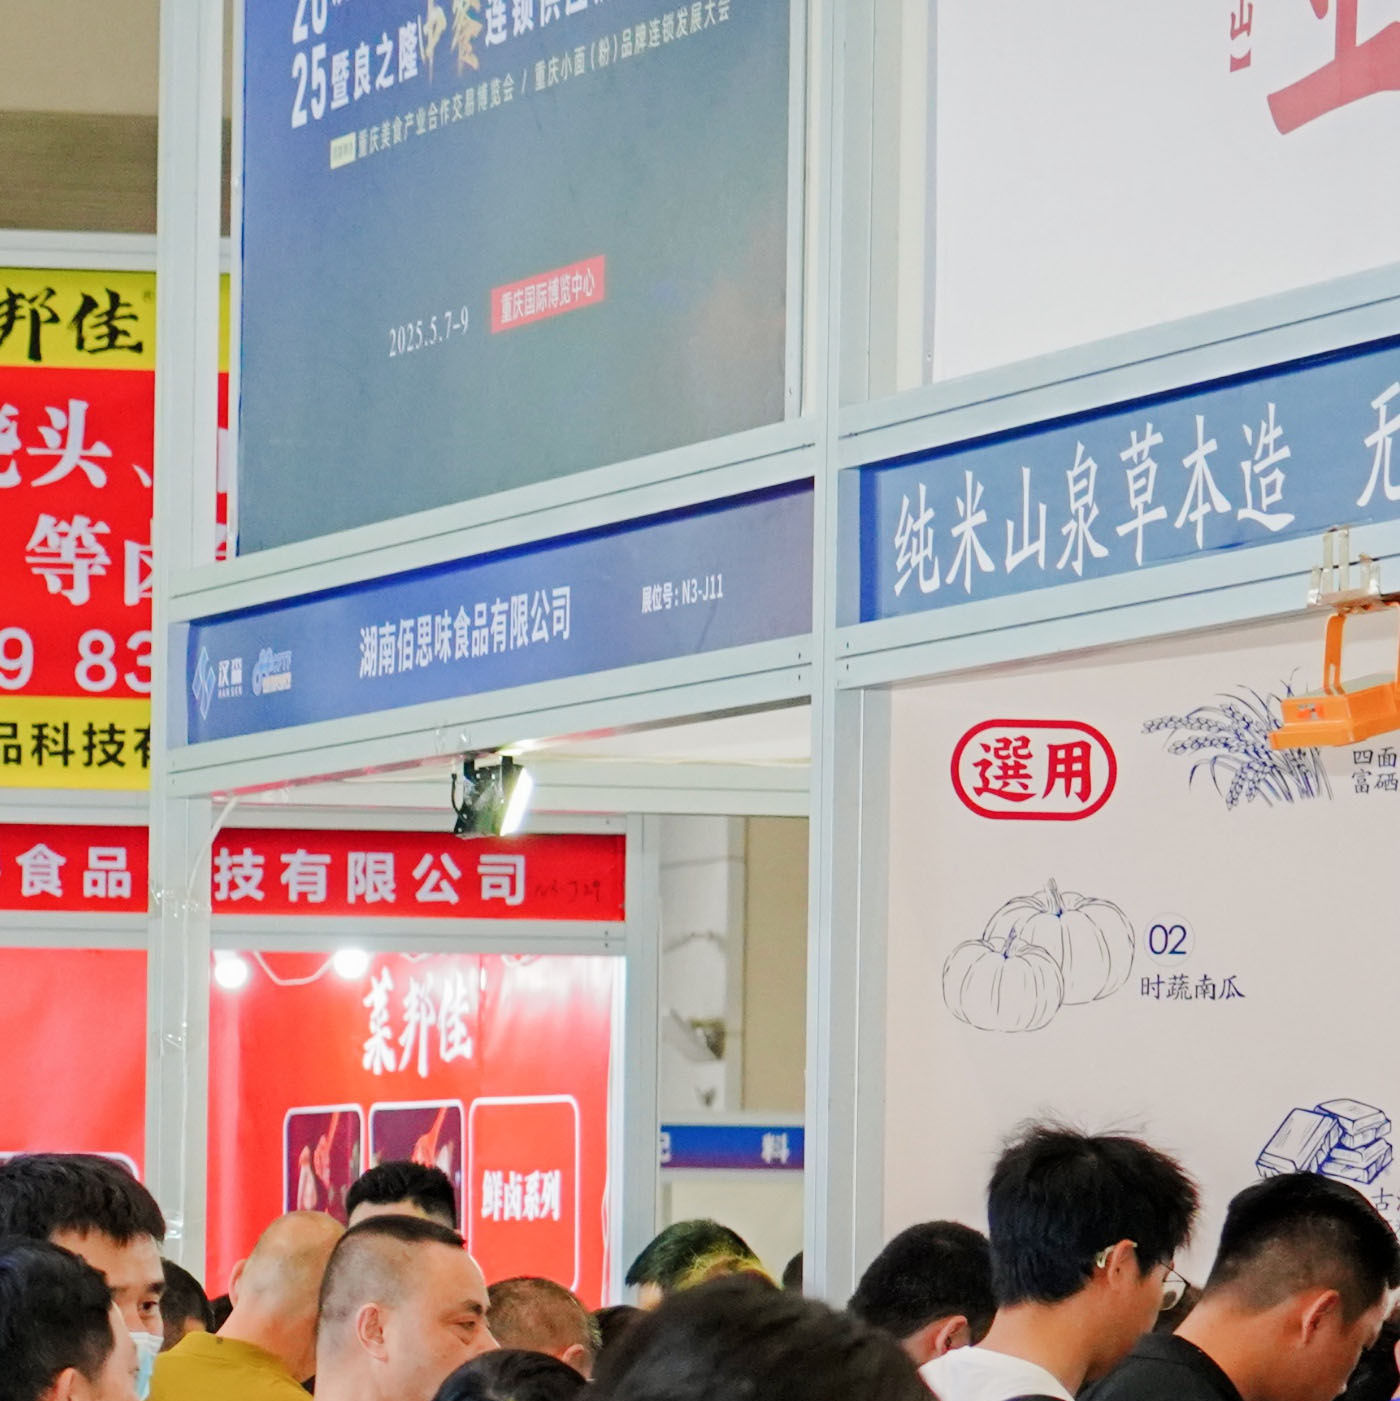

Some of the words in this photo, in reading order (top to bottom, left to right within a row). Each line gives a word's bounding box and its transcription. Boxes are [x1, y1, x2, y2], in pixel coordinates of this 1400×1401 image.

[500, 266, 596, 324] 重庆国际博览中心
[388, 306, 469, 357] 2025.5.7-9
[894, 403, 1295, 596] 纯米山泉草本造
[359, 585, 571, 679] 湖南佰思味食品有限公司
[972, 736, 1093, 804] 選用
[1147, 924, 1187, 956] 02
[1140, 973, 1245, 1001] 时蔬南瓜
[362, 966, 472, 1078] 菜邦佳
[481, 1169, 561, 1222] 鲜卤系列
